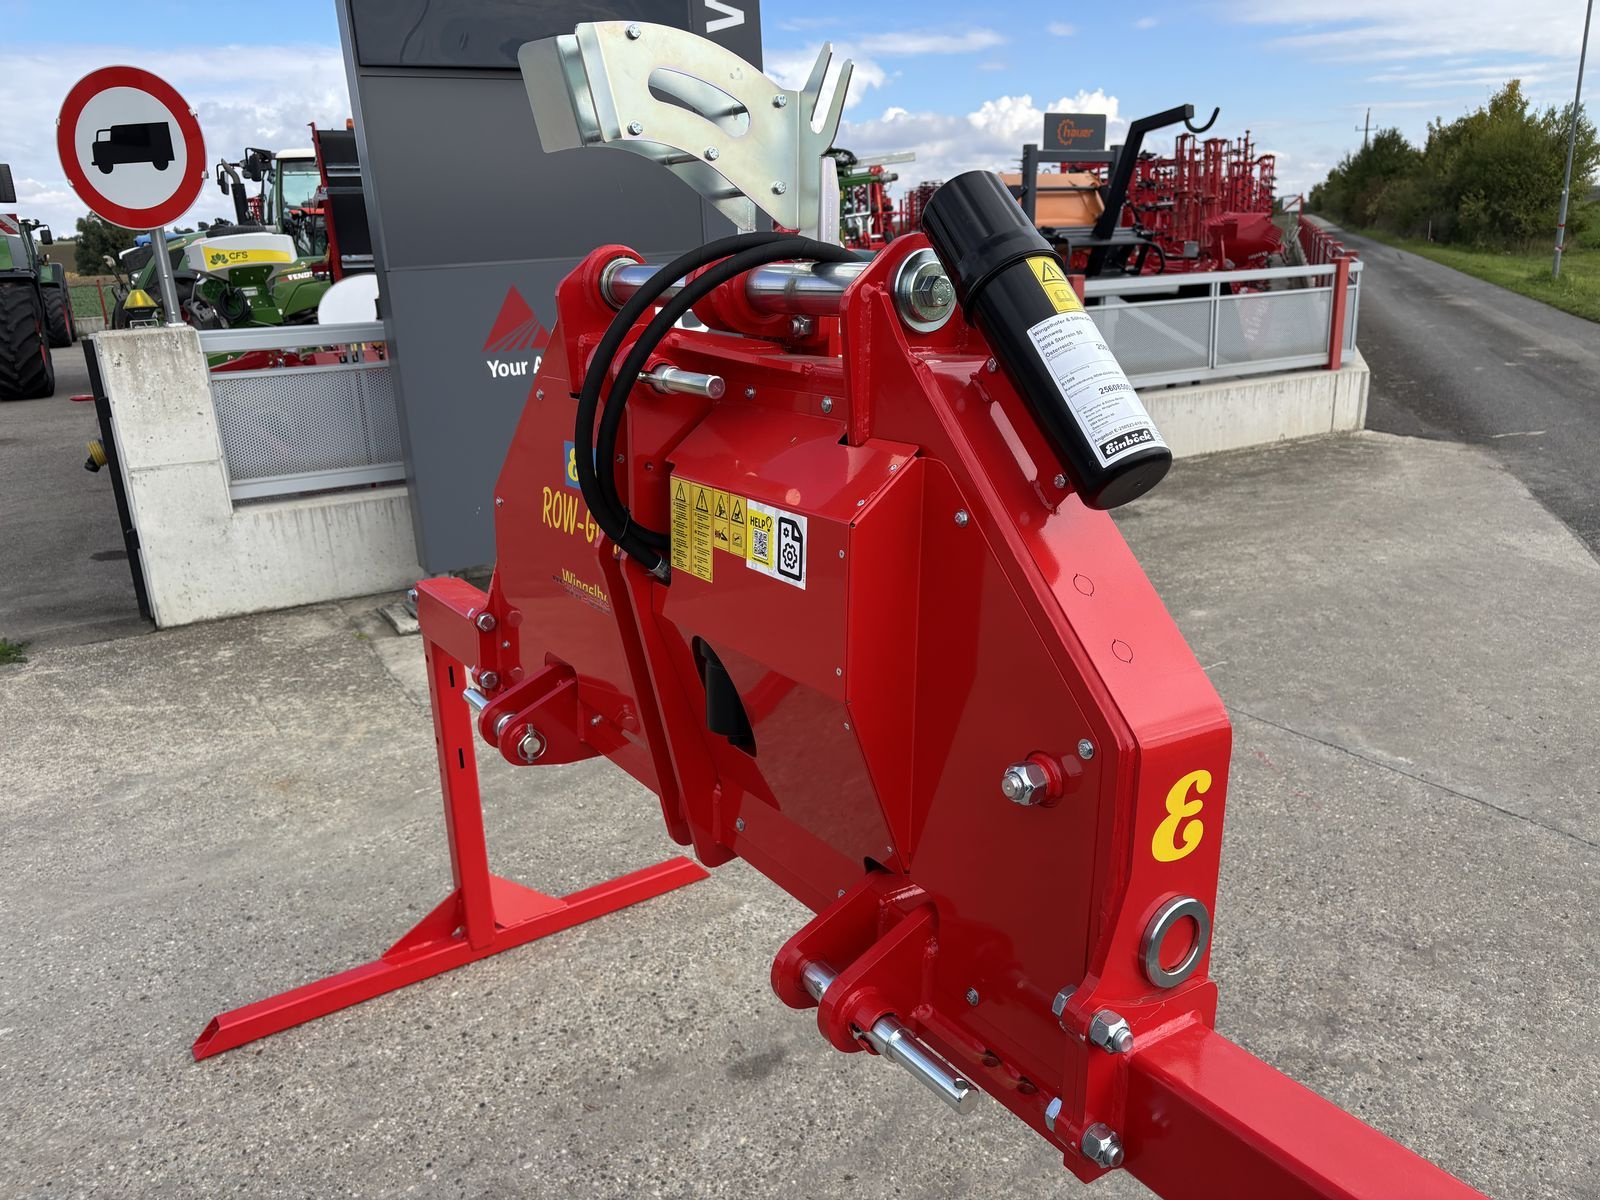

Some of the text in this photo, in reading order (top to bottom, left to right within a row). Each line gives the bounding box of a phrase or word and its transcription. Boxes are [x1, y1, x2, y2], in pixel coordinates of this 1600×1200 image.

[229, 251, 248, 260] CFS
[1038, 328, 1063, 344] Hahnweg
[486, 359, 528, 378] Your
[1104, 430, 1152, 455] Einböck
[543, 486, 600, 543] ROW-G
